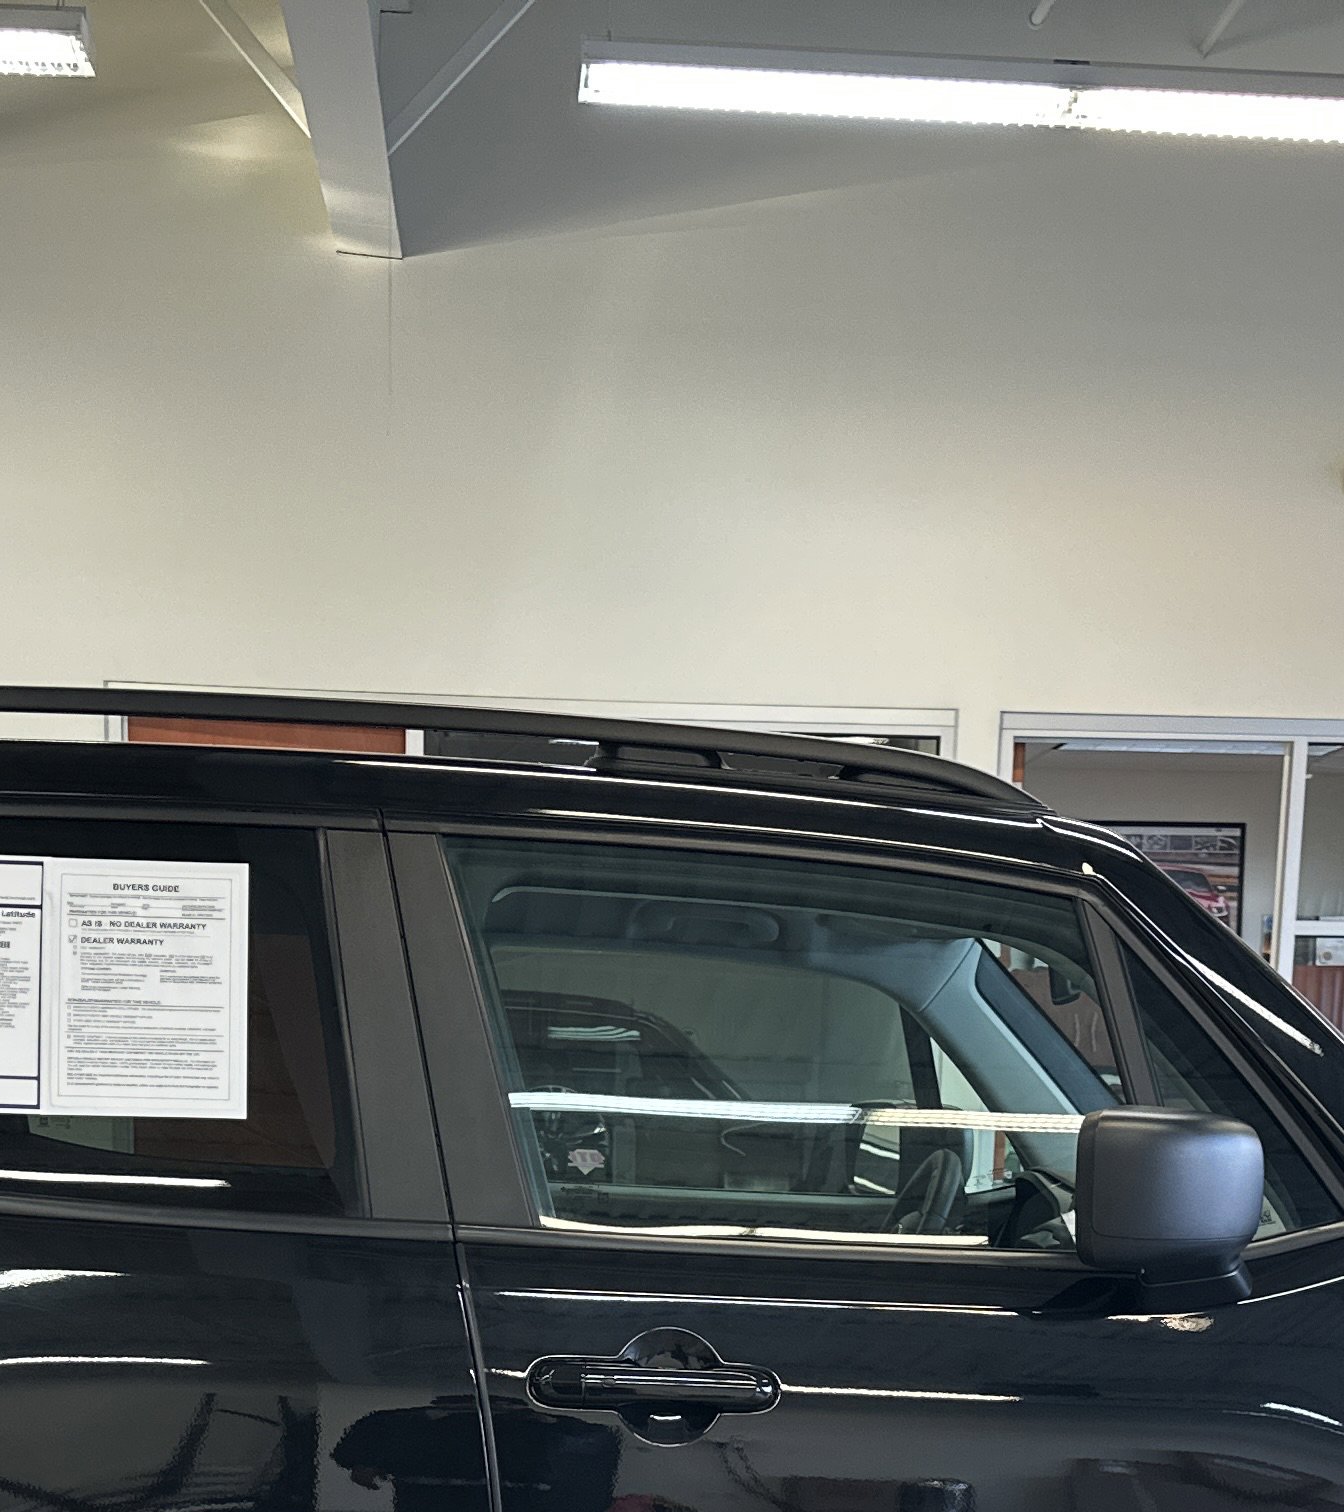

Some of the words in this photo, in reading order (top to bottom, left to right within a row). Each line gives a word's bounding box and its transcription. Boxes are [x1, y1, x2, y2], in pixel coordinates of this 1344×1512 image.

[112, 883, 150, 892] BUYERS
[151, 884, 180, 893] GUIDE
[1, 909, 36, 918] Latitude
[124, 921, 158, 929] DEALER
[159, 922, 207, 931] WARRANTY
[80, 936, 115, 944] DEALER
[116, 937, 165, 946] WARRANTY
